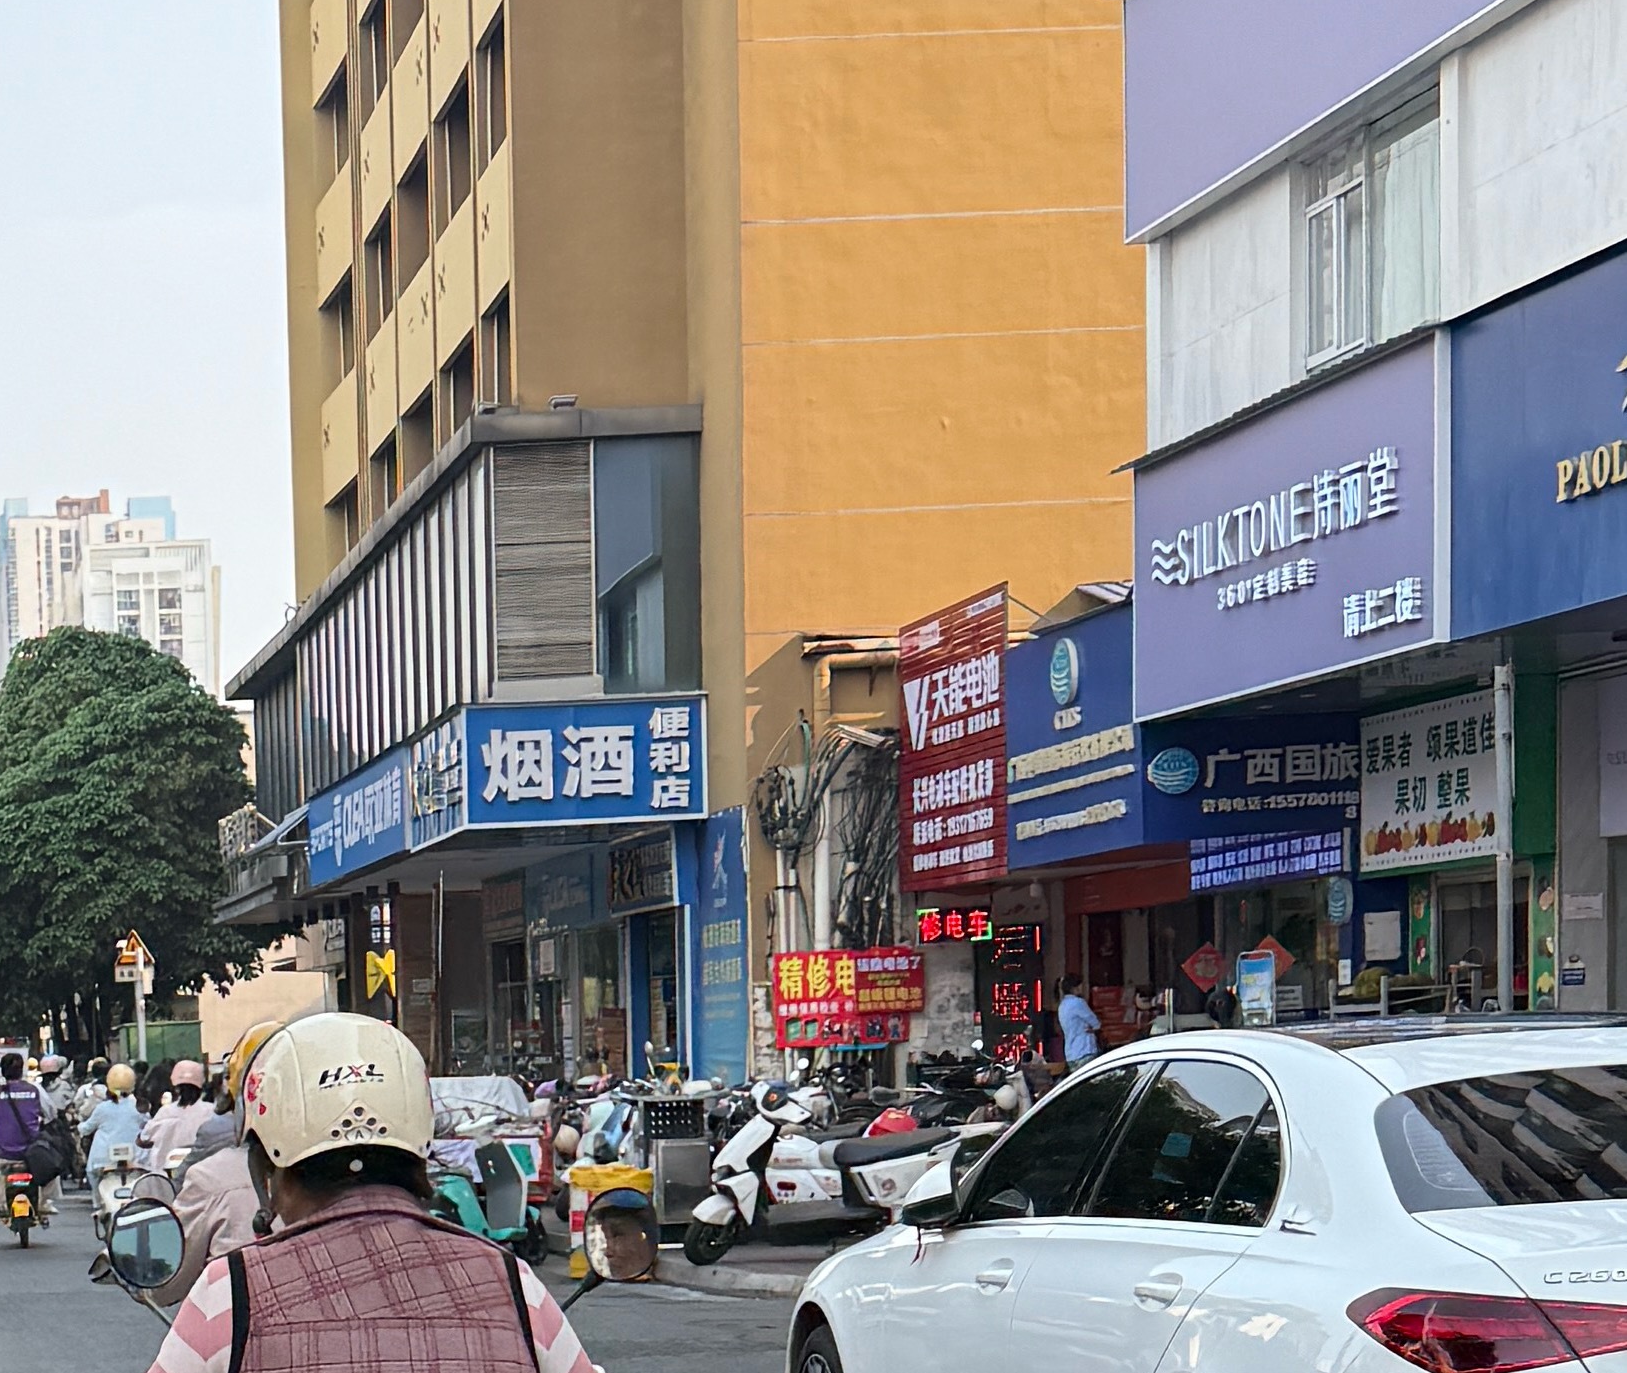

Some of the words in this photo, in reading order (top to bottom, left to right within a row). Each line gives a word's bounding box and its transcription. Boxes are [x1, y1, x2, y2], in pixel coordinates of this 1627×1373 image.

[931, 650, 1000, 722] 天能电池
[481, 725, 635, 803] 烟酒
[648, 707, 691, 809] 便利店
[1204, 741, 1360, 789] 广西国旅
[1394, 776, 1427, 816] 果切
[1436, 767, 1471, 810] 整果
